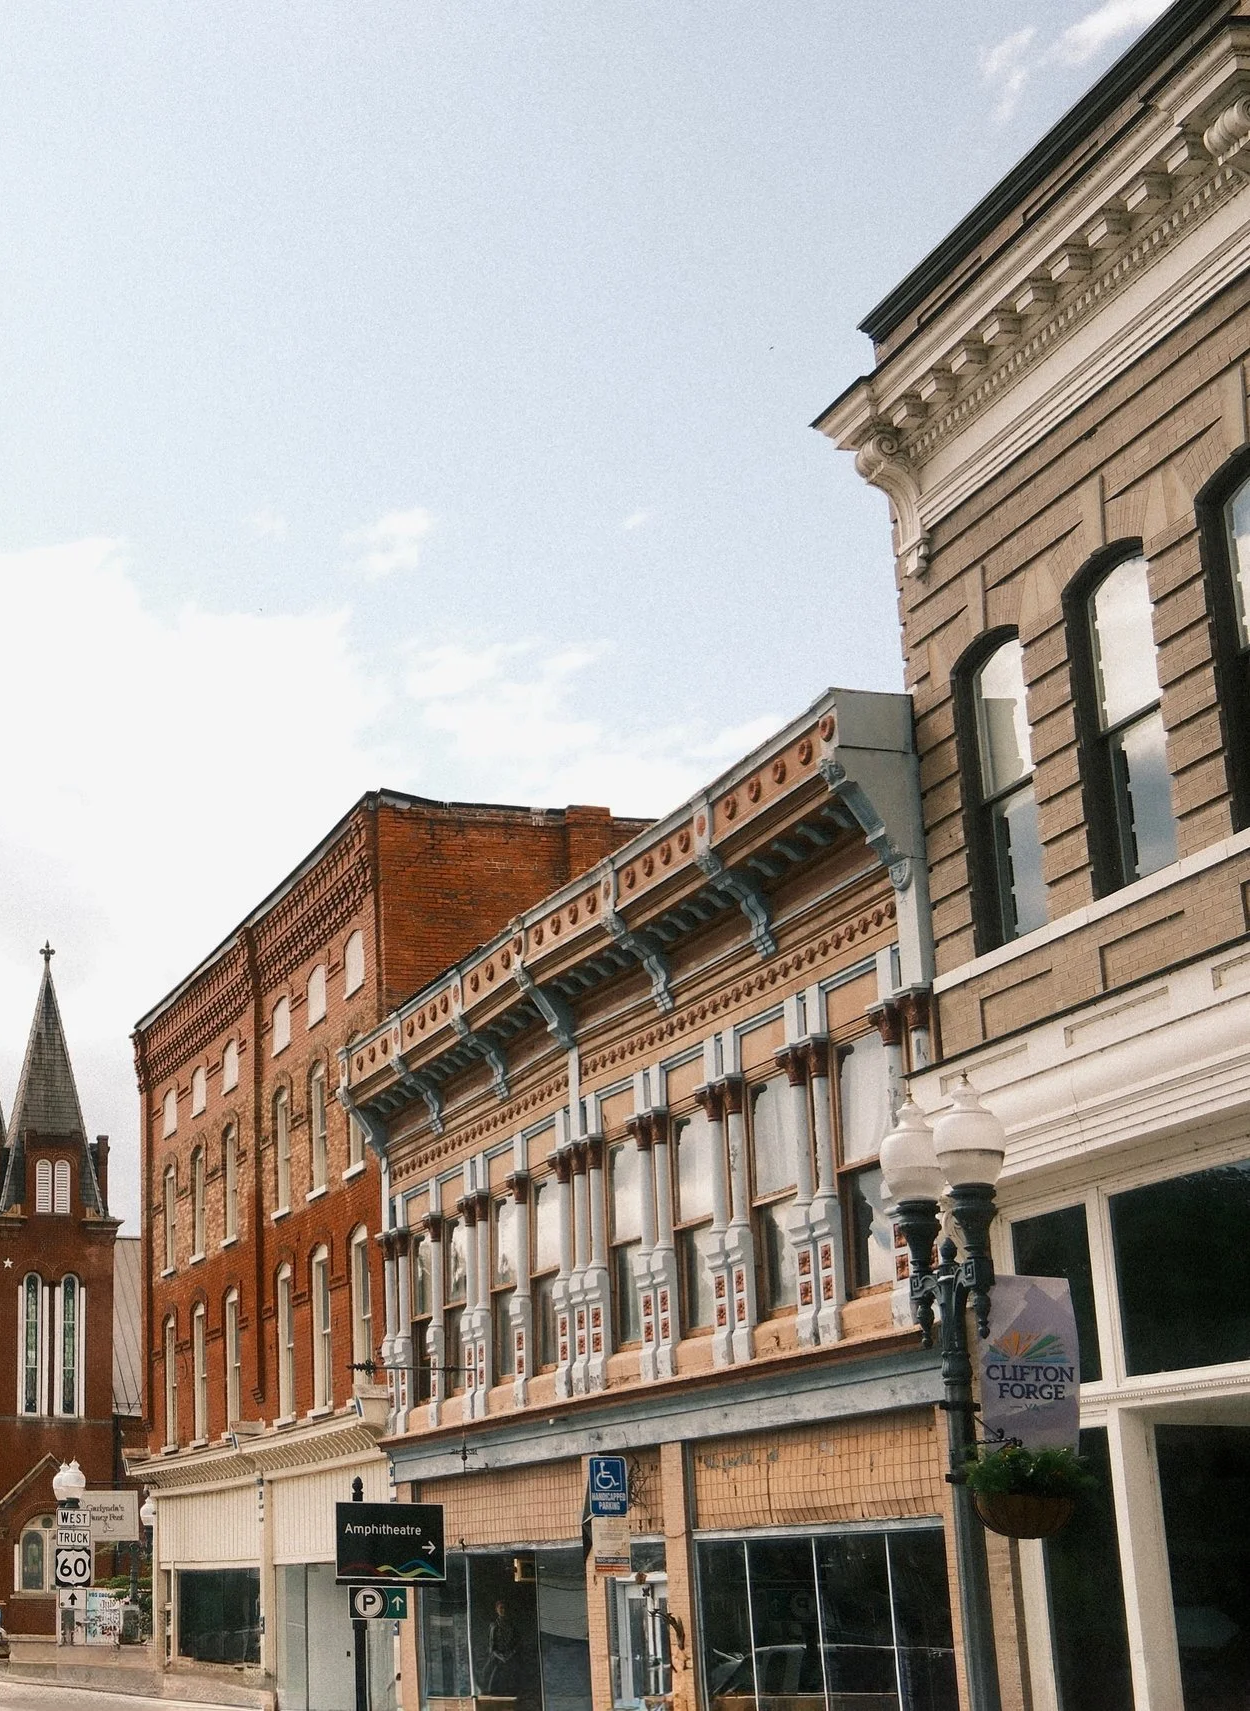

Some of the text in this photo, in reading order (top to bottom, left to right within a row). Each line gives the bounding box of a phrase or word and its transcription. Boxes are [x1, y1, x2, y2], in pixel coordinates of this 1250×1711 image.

[986, 1364, 1075, 1382] CLIFTON
[997, 1382, 1065, 1400] FORGE
[591, 1492, 626, 1501] HANDICAPPED
[598, 1501, 621, 1510] PARKING
[61, 1511, 87, 1524] WEST
[91, 1514, 109, 1522] ancy
[344, 1523, 422, 1537] Amphitheatre
[59, 1532, 88, 1544] TRUCK
[60, 1557, 87, 1577] 60
[362, 1594, 377, 1611] P
